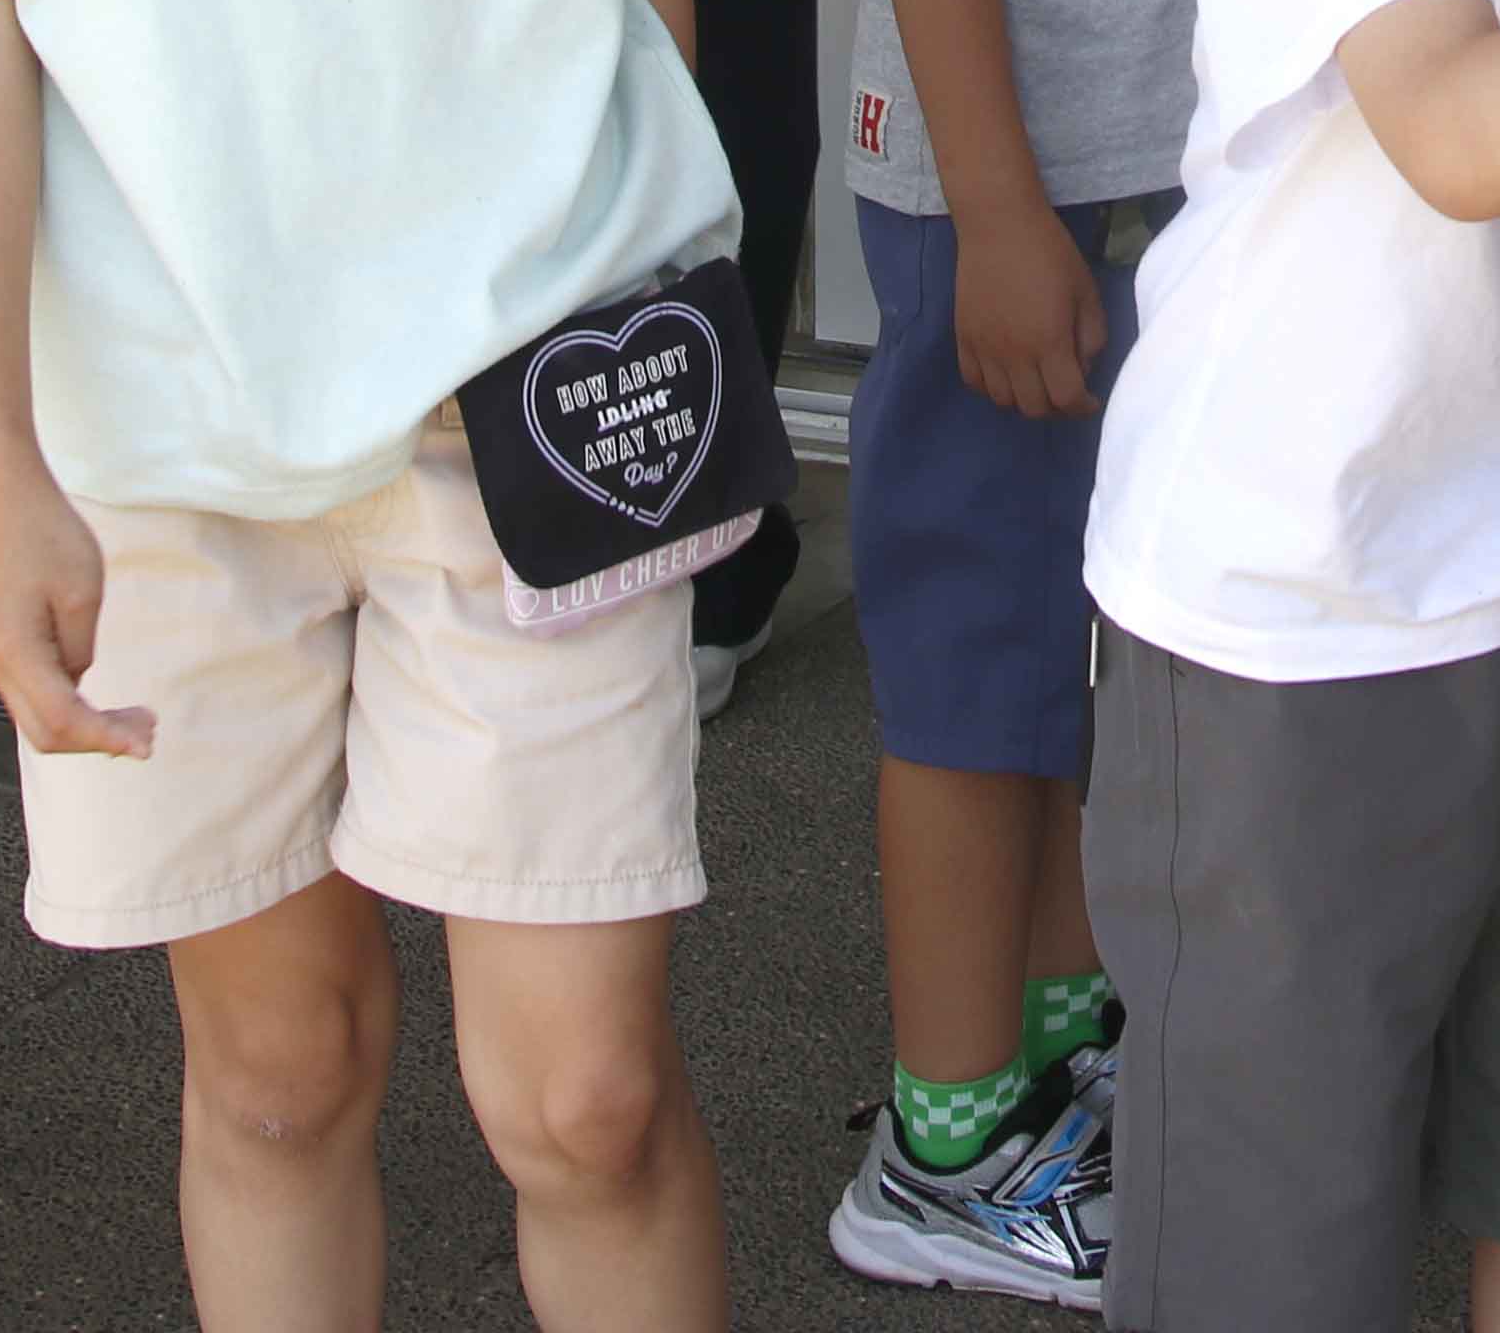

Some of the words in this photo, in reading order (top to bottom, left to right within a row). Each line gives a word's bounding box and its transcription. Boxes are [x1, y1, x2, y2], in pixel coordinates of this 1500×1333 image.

[860, 92, 885, 155] H
[556, 373, 608, 414] HOW
[618, 344, 689, 394] ABOUT
[584, 425, 647, 473] AWAY
[652, 408, 697, 447] THE
[623, 450, 679, 489] Day?
[551, 572, 606, 614] LUV
[619, 533, 700, 591] CHEER
